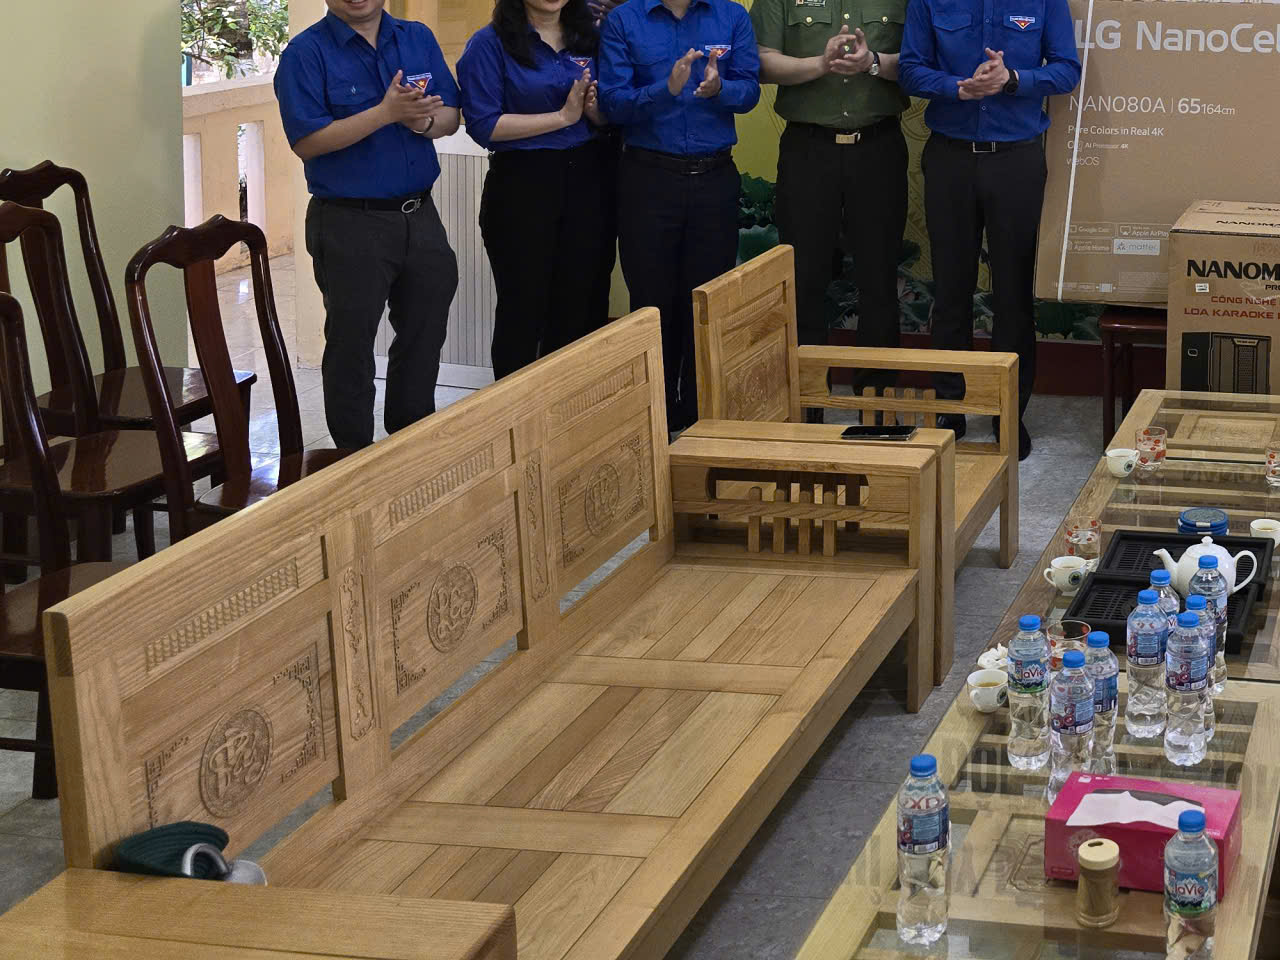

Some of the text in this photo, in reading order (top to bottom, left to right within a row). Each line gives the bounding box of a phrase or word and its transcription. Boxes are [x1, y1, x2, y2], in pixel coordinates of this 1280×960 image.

[1074, 19, 1121, 49] LG
[1177, 98, 1200, 114] 65
[1201, 104, 1235, 115] 164cm
[1068, 125, 1164, 136] Pre Colors in Real 4K
[1211, 295, 1243, 304] CÔNG
[1184, 307, 1209, 317] LOA
[1212, 309, 1274, 320] KARAOKE
